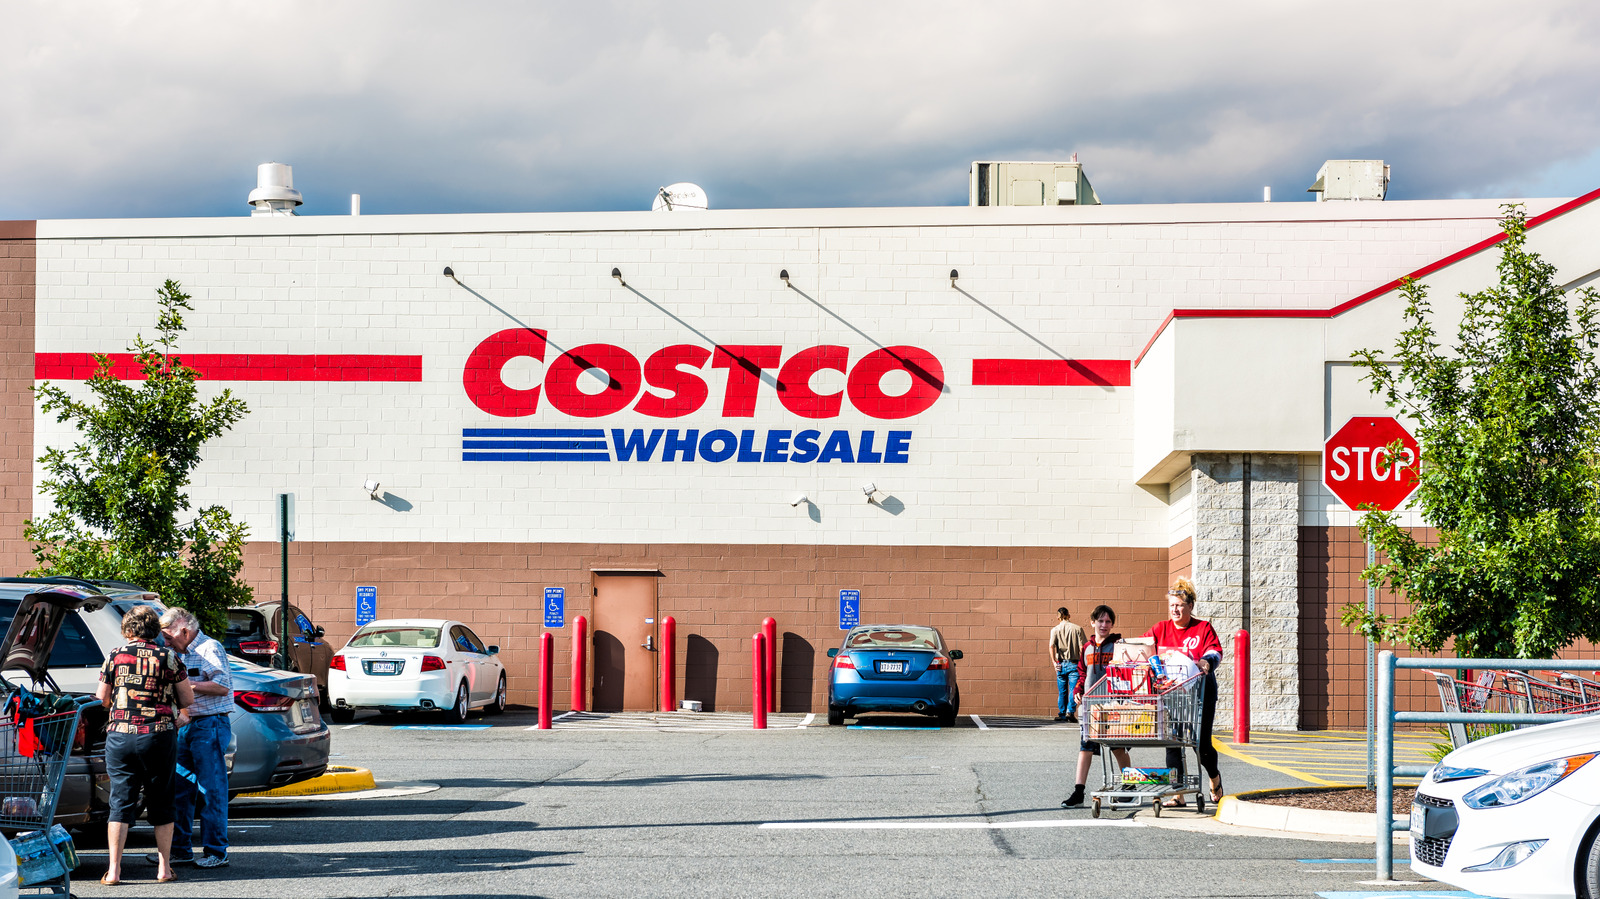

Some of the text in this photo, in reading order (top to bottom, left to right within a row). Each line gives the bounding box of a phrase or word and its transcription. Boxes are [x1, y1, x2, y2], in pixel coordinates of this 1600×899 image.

[463, 328, 945, 419] COSTCO
[611, 429, 912, 463] WHOLESALE
[1330, 446, 1415, 481] STOP
